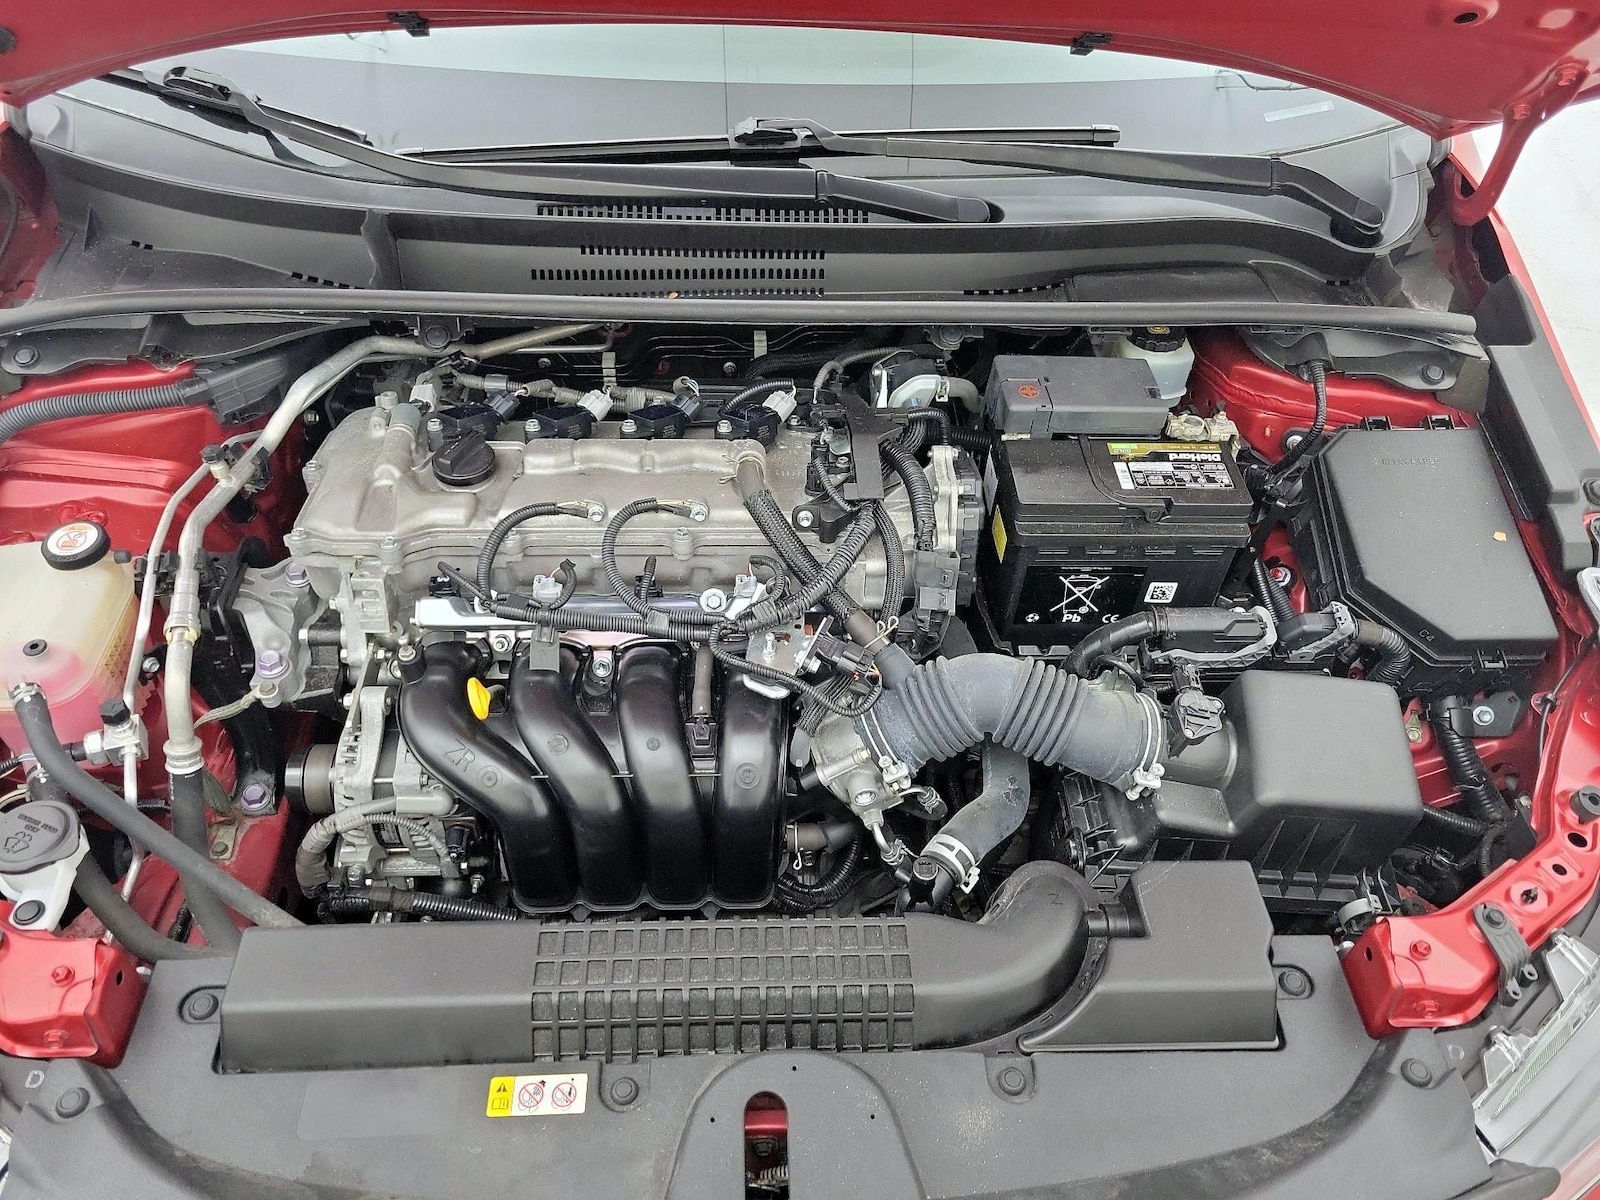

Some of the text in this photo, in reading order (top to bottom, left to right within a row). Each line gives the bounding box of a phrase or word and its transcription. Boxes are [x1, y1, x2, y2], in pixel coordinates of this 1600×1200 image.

[1169, 453, 1221, 462] DieHard
[1062, 613, 1082, 623] Pb
[442, 738, 476, 772] ZR
